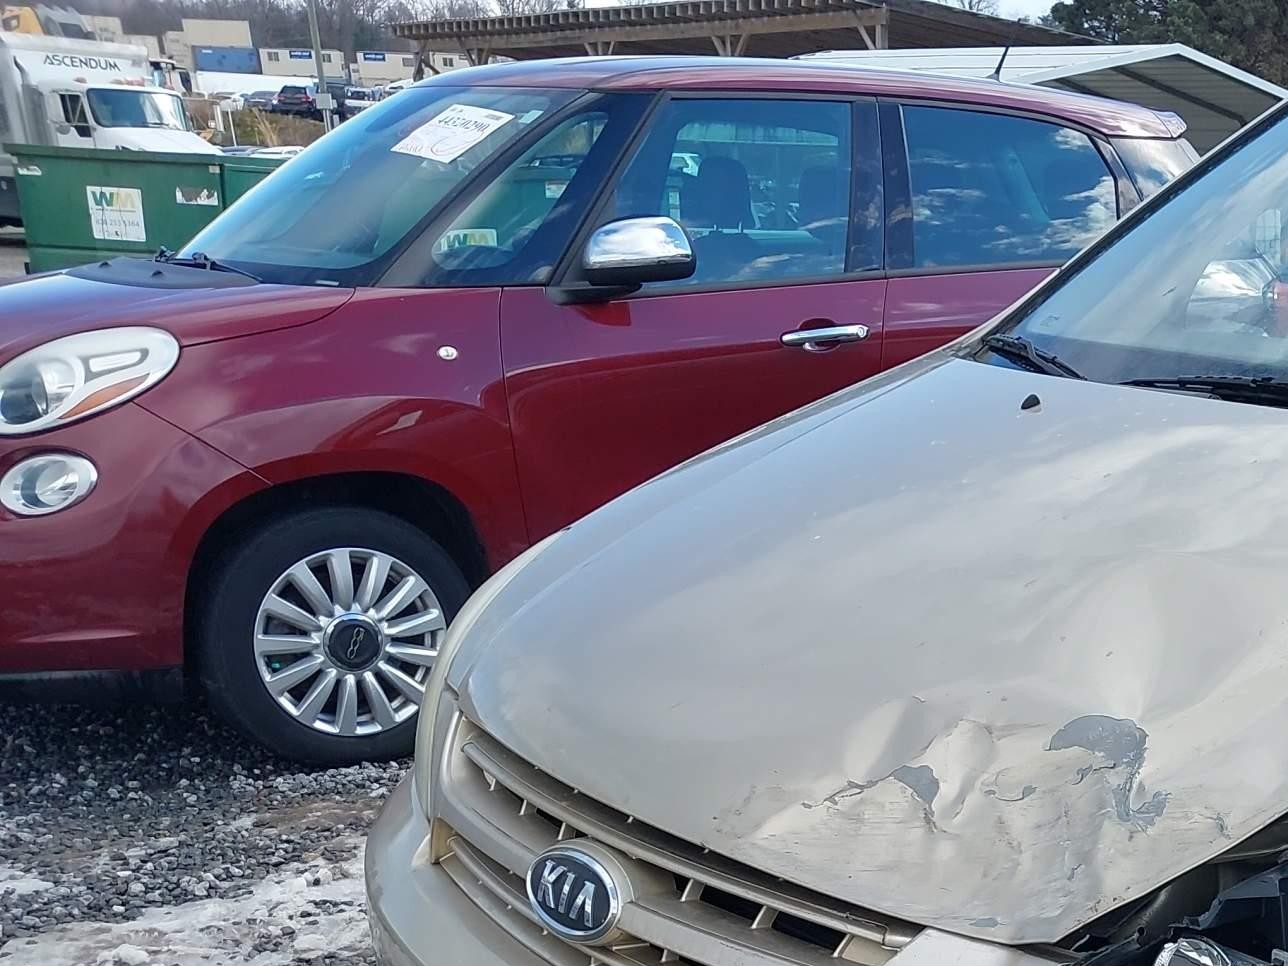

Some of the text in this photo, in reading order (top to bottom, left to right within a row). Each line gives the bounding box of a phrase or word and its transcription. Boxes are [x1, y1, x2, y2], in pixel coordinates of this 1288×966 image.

[43, 54, 121, 72] ASCENDUM
[90, 190, 137, 209] WM
[537, 859, 597, 928] KIA
